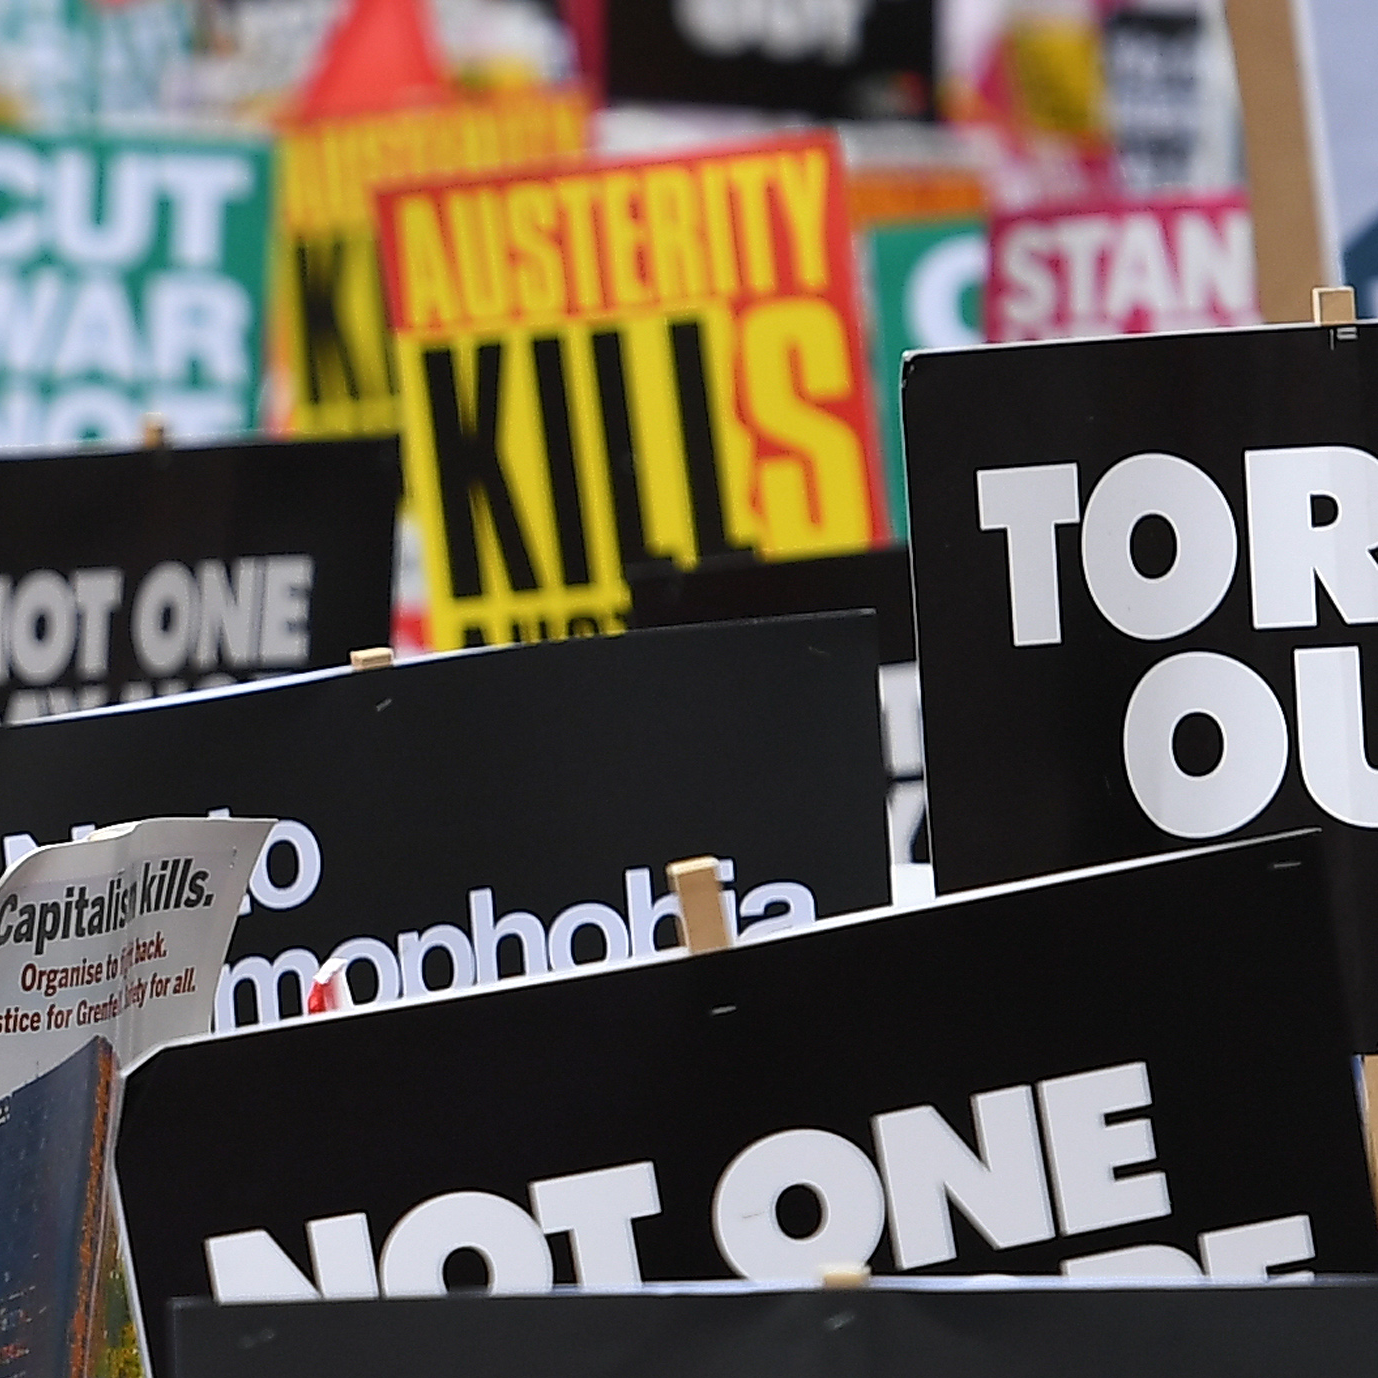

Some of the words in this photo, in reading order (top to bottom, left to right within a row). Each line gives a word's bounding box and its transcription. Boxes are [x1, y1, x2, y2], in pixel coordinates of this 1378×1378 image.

[400, 148, 834, 325] AUSTERITY
[1002, 208, 1254, 325] STAN
[422, 300, 874, 600] KILLS
[132, 555, 316, 672] ONE
[139, 857, 215, 916] kills.
[20, 956, 104, 998] Organise
[105, 952, 120, 981] to
[133, 930, 169, 965] back.
[45, 1001, 74, 1032] for
[76, 990, 123, 1028] Grenfe
[147, 971, 172, 1000] for
[171, 965, 197, 996] all.
[711, 1060, 1172, 1284] ONE
